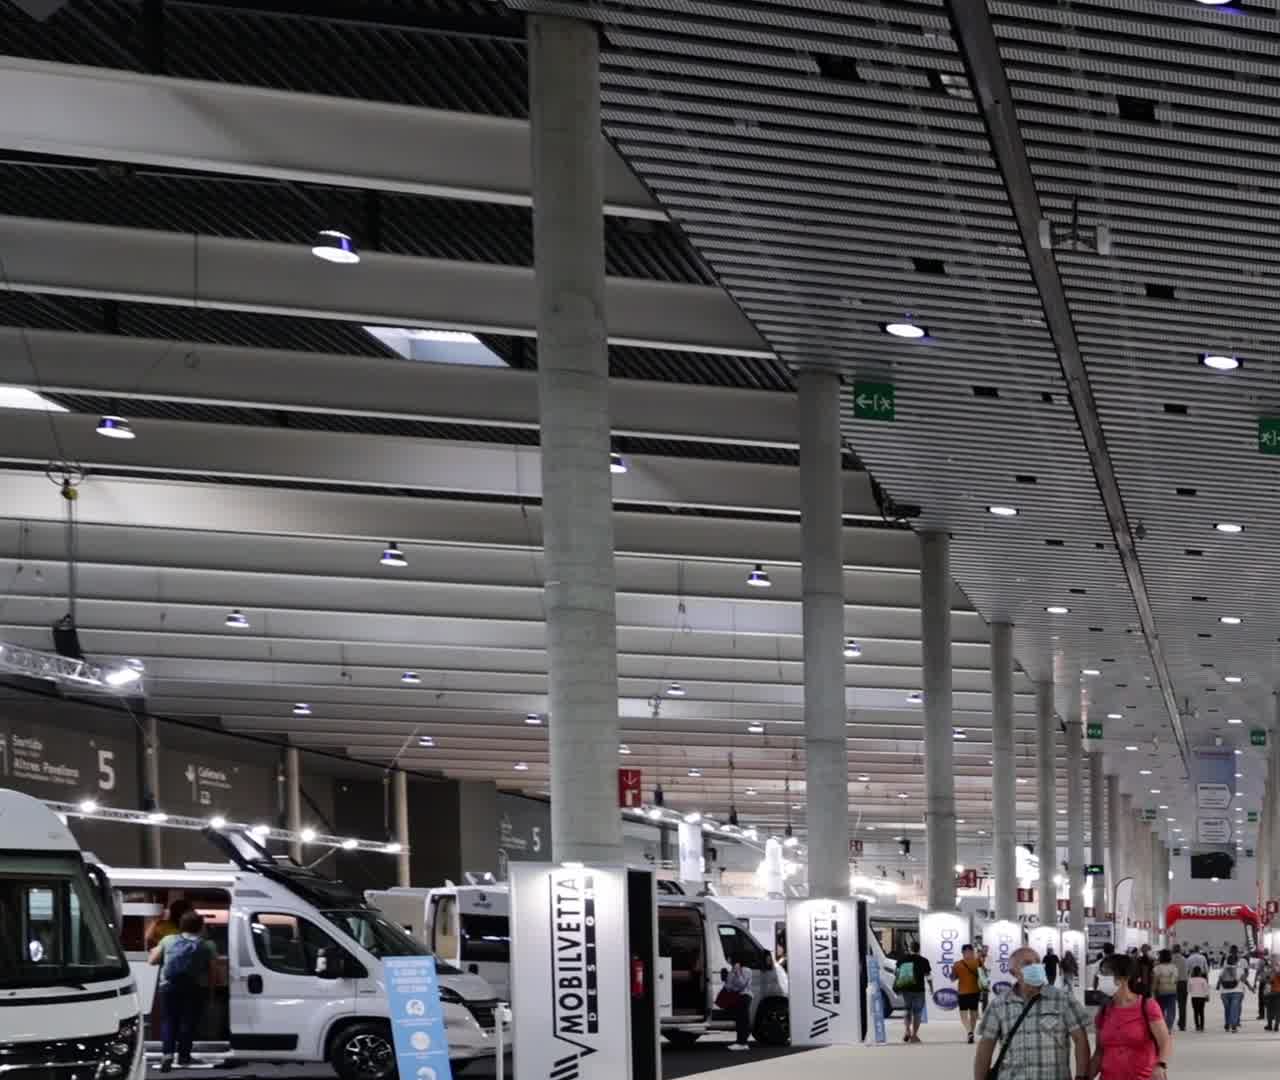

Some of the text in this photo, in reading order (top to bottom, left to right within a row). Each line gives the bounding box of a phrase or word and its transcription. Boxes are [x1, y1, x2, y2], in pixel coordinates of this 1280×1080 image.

[96, 750, 115, 790] 5
[531, 826, 541, 852] 5
[1180, 905, 1241, 917] PROBIKE
[556, 878, 584, 1034] MOBILVETTA
